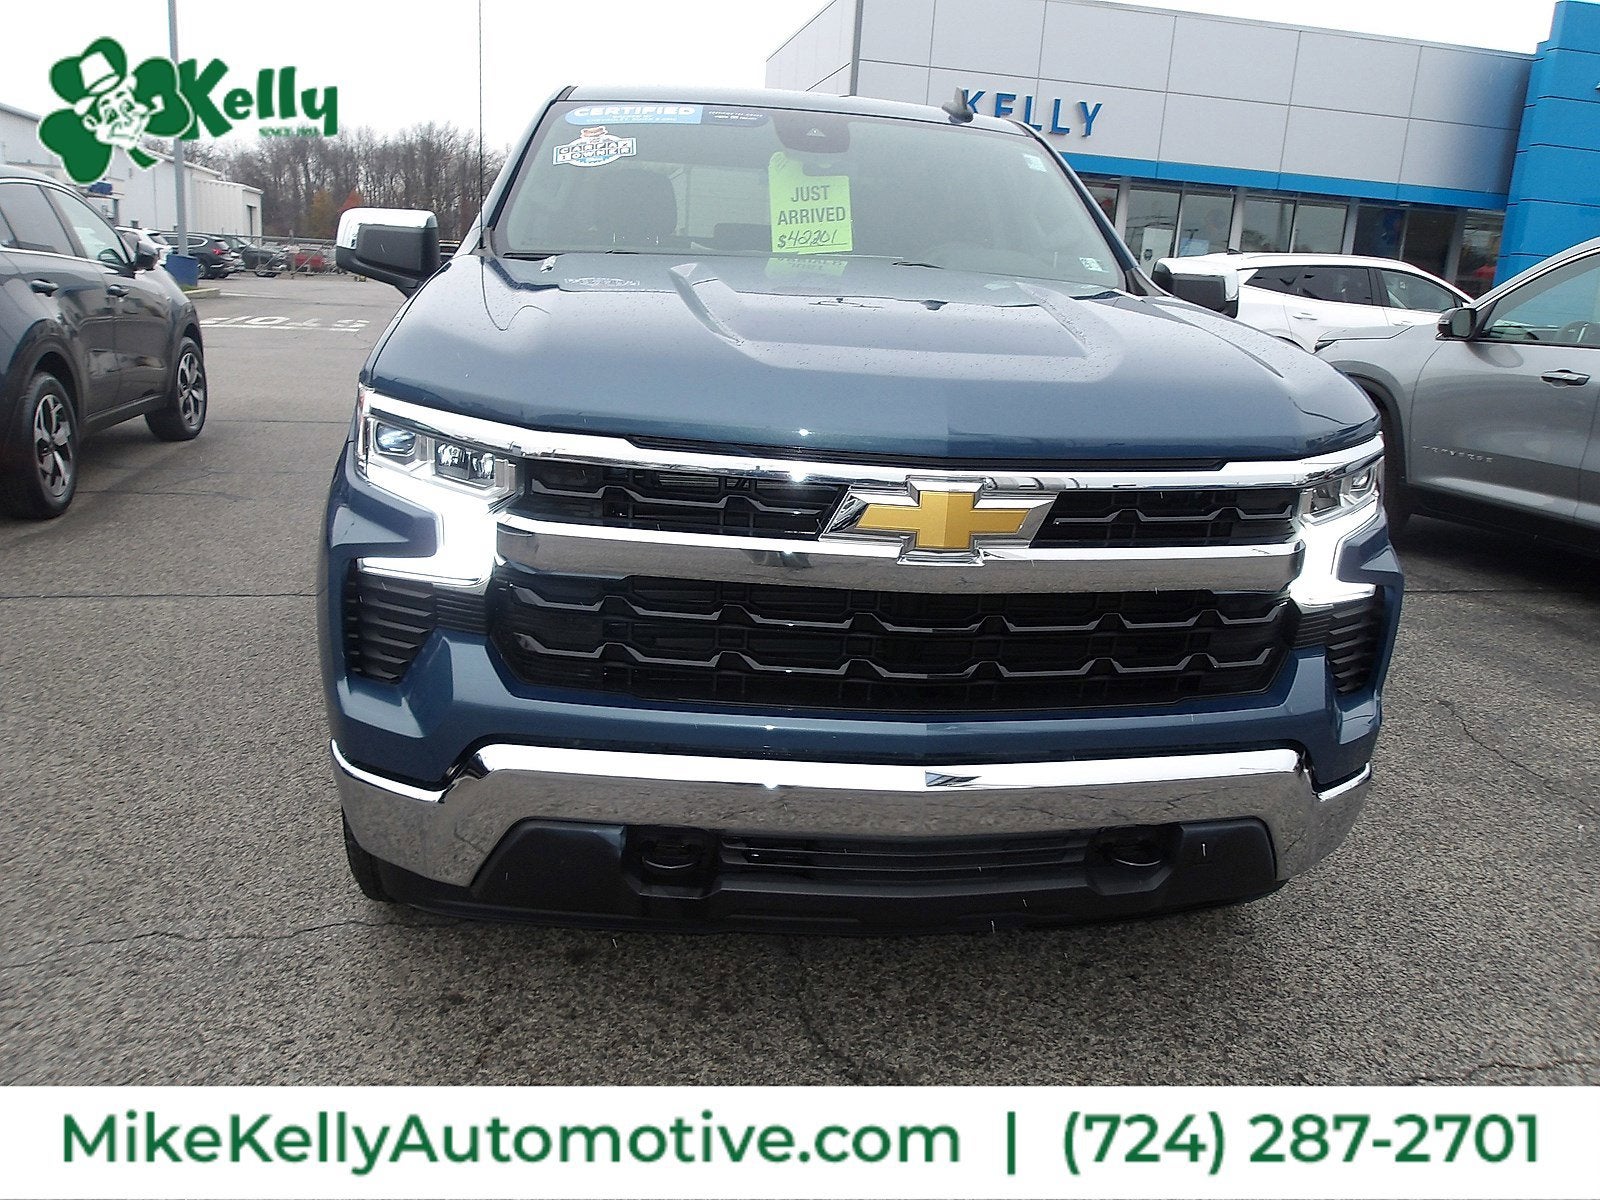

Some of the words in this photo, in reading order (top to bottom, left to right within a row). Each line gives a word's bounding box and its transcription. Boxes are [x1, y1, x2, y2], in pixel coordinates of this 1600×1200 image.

[573, 105, 696, 117] CERTIFIED
[964, 89, 1103, 137] KELLY
[791, 185, 830, 202] JUST
[777, 206, 846, 225] ARRIVED
